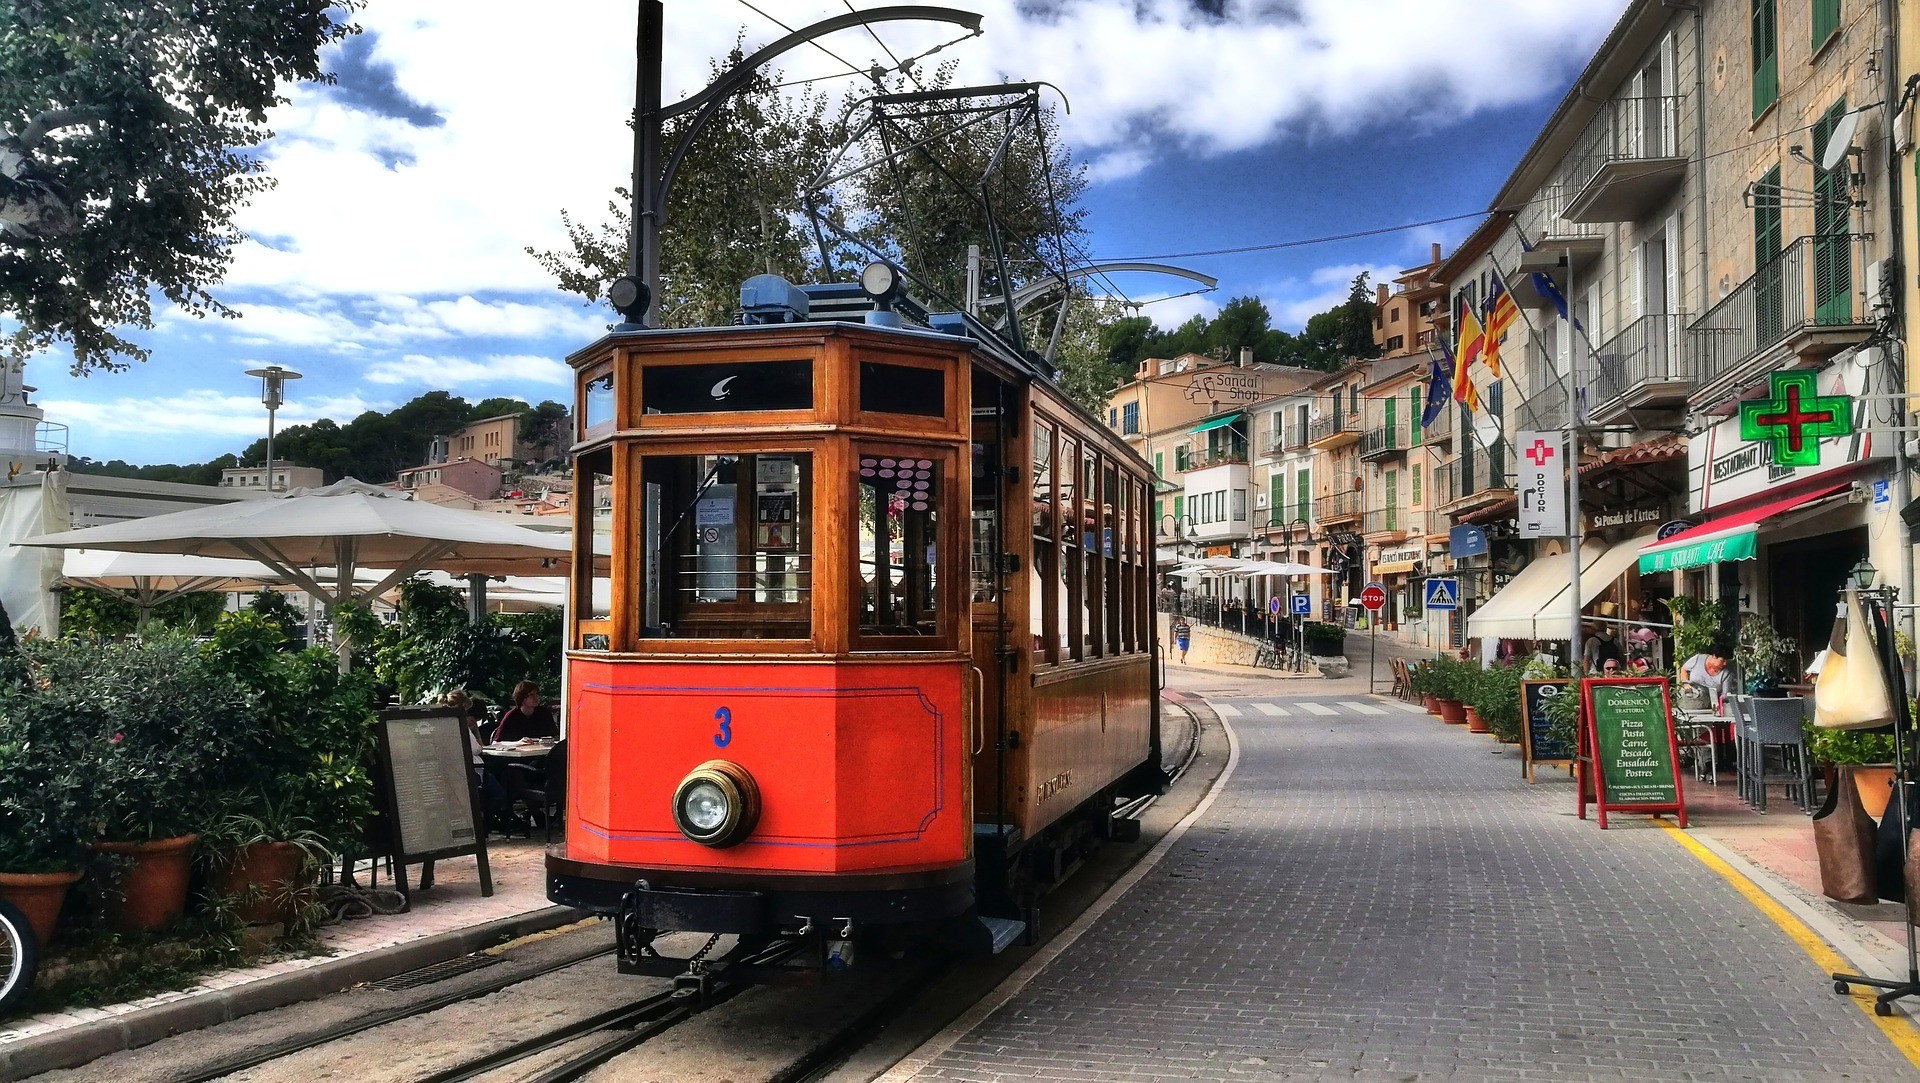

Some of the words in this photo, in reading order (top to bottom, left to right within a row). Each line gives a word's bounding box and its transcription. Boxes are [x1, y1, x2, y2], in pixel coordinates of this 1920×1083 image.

[1217, 374, 1258, 388] Sandal
[1230, 387, 1260, 402] Shop
[1537, 473, 1546, 512] DOCTOR
[1594, 515, 1602, 528] Sa
[1602, 511, 1624, 527] Posada
[1625, 510, 1633, 524] de
[1707, 539, 1727, 560] CAFÉ
[1495, 574, 1503, 584] Sa
[1295, 596, 1307, 611] P
[714, 706, 731, 748] 3
[1621, 719, 1643, 728] Pizza
[1622, 729, 1645, 738] Pasta
[1622, 739, 1648, 748] Carne
[1621, 748, 1652, 757] Pescado
[1616, 758, 1659, 767] Ensaladas
[1625, 769, 1653, 777] Postres
